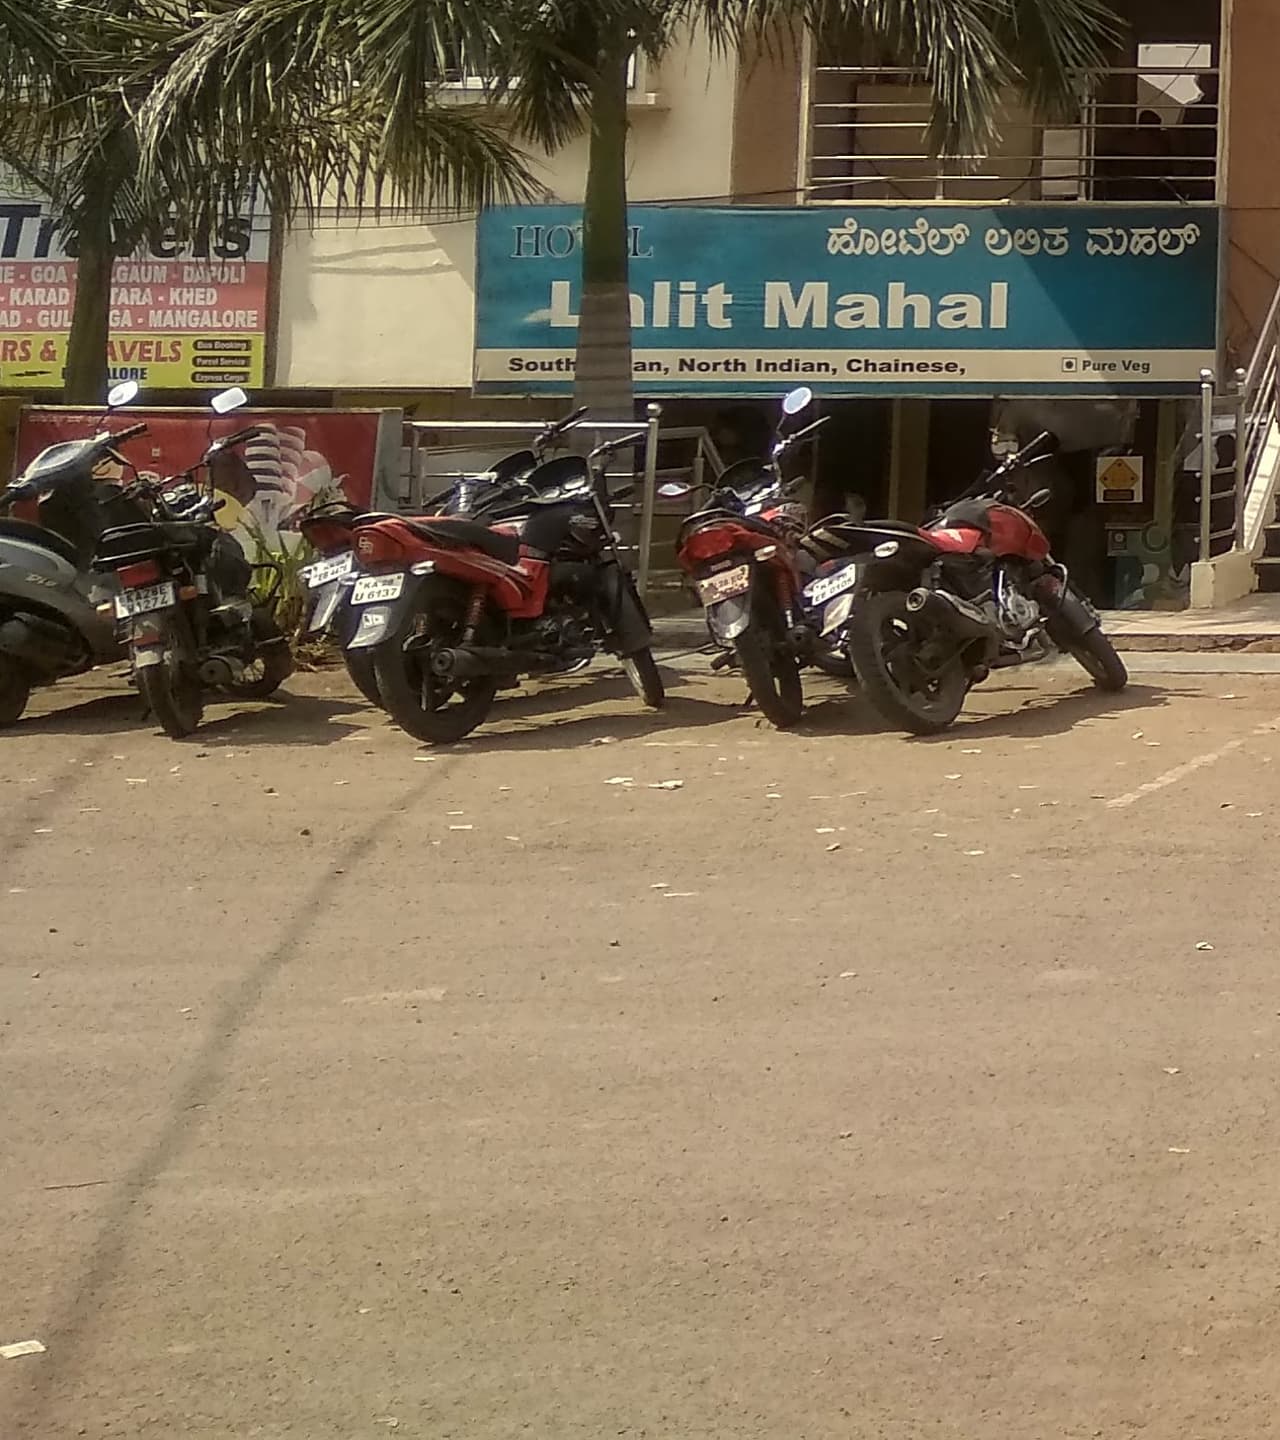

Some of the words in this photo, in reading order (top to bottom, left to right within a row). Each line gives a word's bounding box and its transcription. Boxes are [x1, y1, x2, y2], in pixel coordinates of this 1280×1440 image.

[826, 217, 970, 257] ಹೋಟೆಲ್
[984, 224, 1070, 257] ಲಲಿತ
[1086, 221, 1201, 257] ಮಹಲ್
[10, 287, 70, 306] KARAD
[169, 288, 218, 306] KHED
[764, 280, 1009, 330] Mahal
[150, 310, 258, 329] MANGALORE
[508, 357, 577, 373] South
[678, 358, 747, 373] North
[755, 358, 838, 376] Indian,
[845, 358, 967, 376] Chainese,
[1081, 359, 1120, 373] Pure
[1122, 359, 1151, 375] Veg
